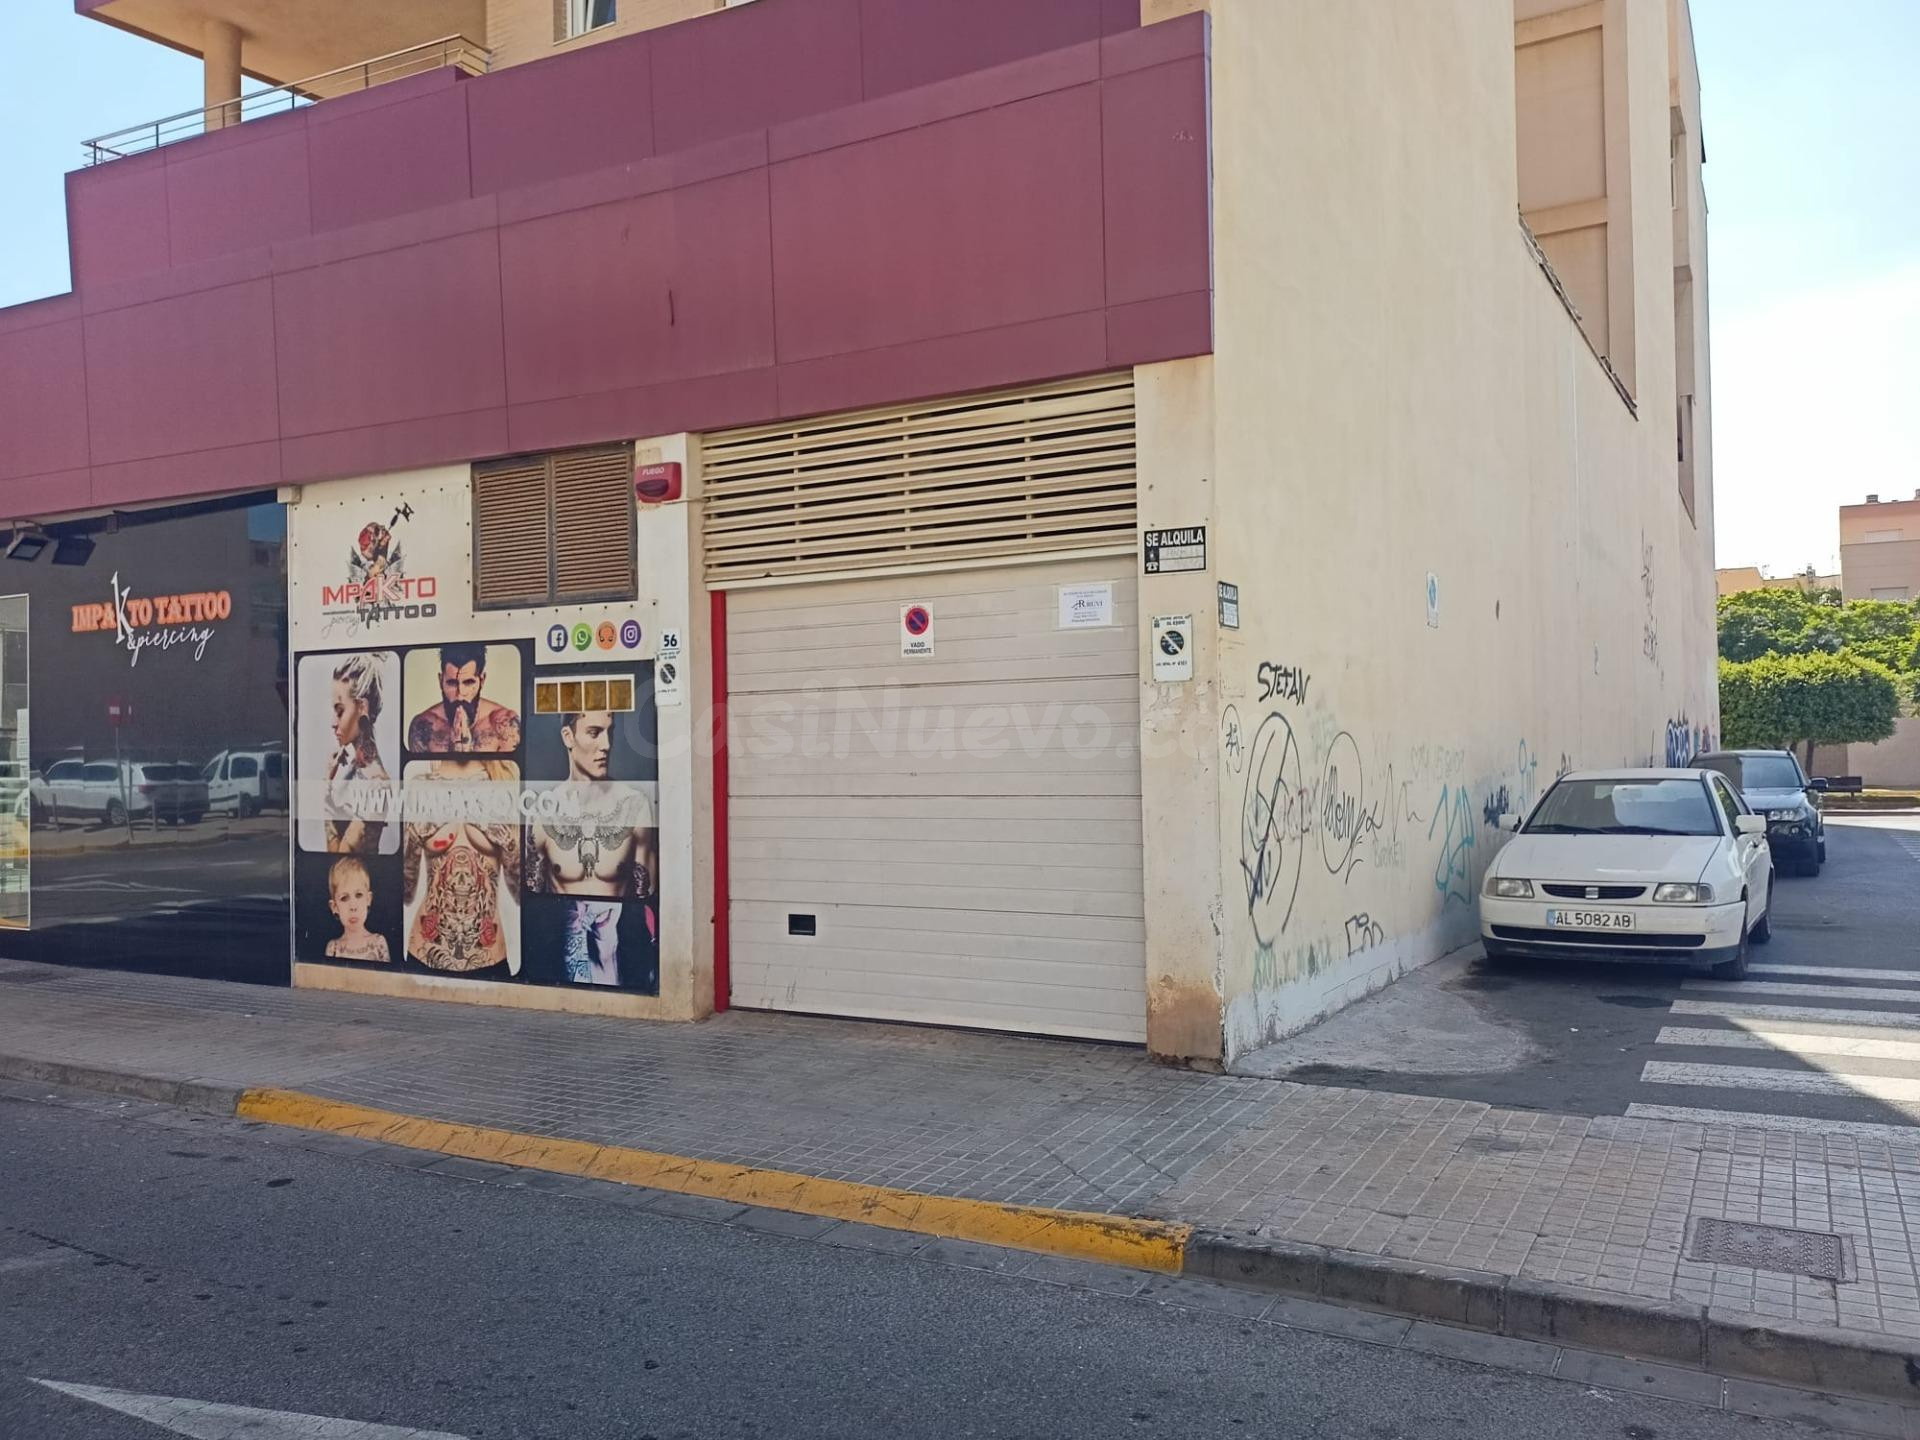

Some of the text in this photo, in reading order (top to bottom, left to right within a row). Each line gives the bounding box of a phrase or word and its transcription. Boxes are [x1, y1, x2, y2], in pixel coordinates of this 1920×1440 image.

[1146, 529, 1204, 547] SE ALQUILA
[322, 574, 436, 607] IMPAKTO
[71, 571, 232, 644] IMPAKTO TATTOO
[356, 603, 437, 622] TATTOO
[663, 634, 677, 648] 56
[1556, 911, 1632, 928] AL 5082 AB
